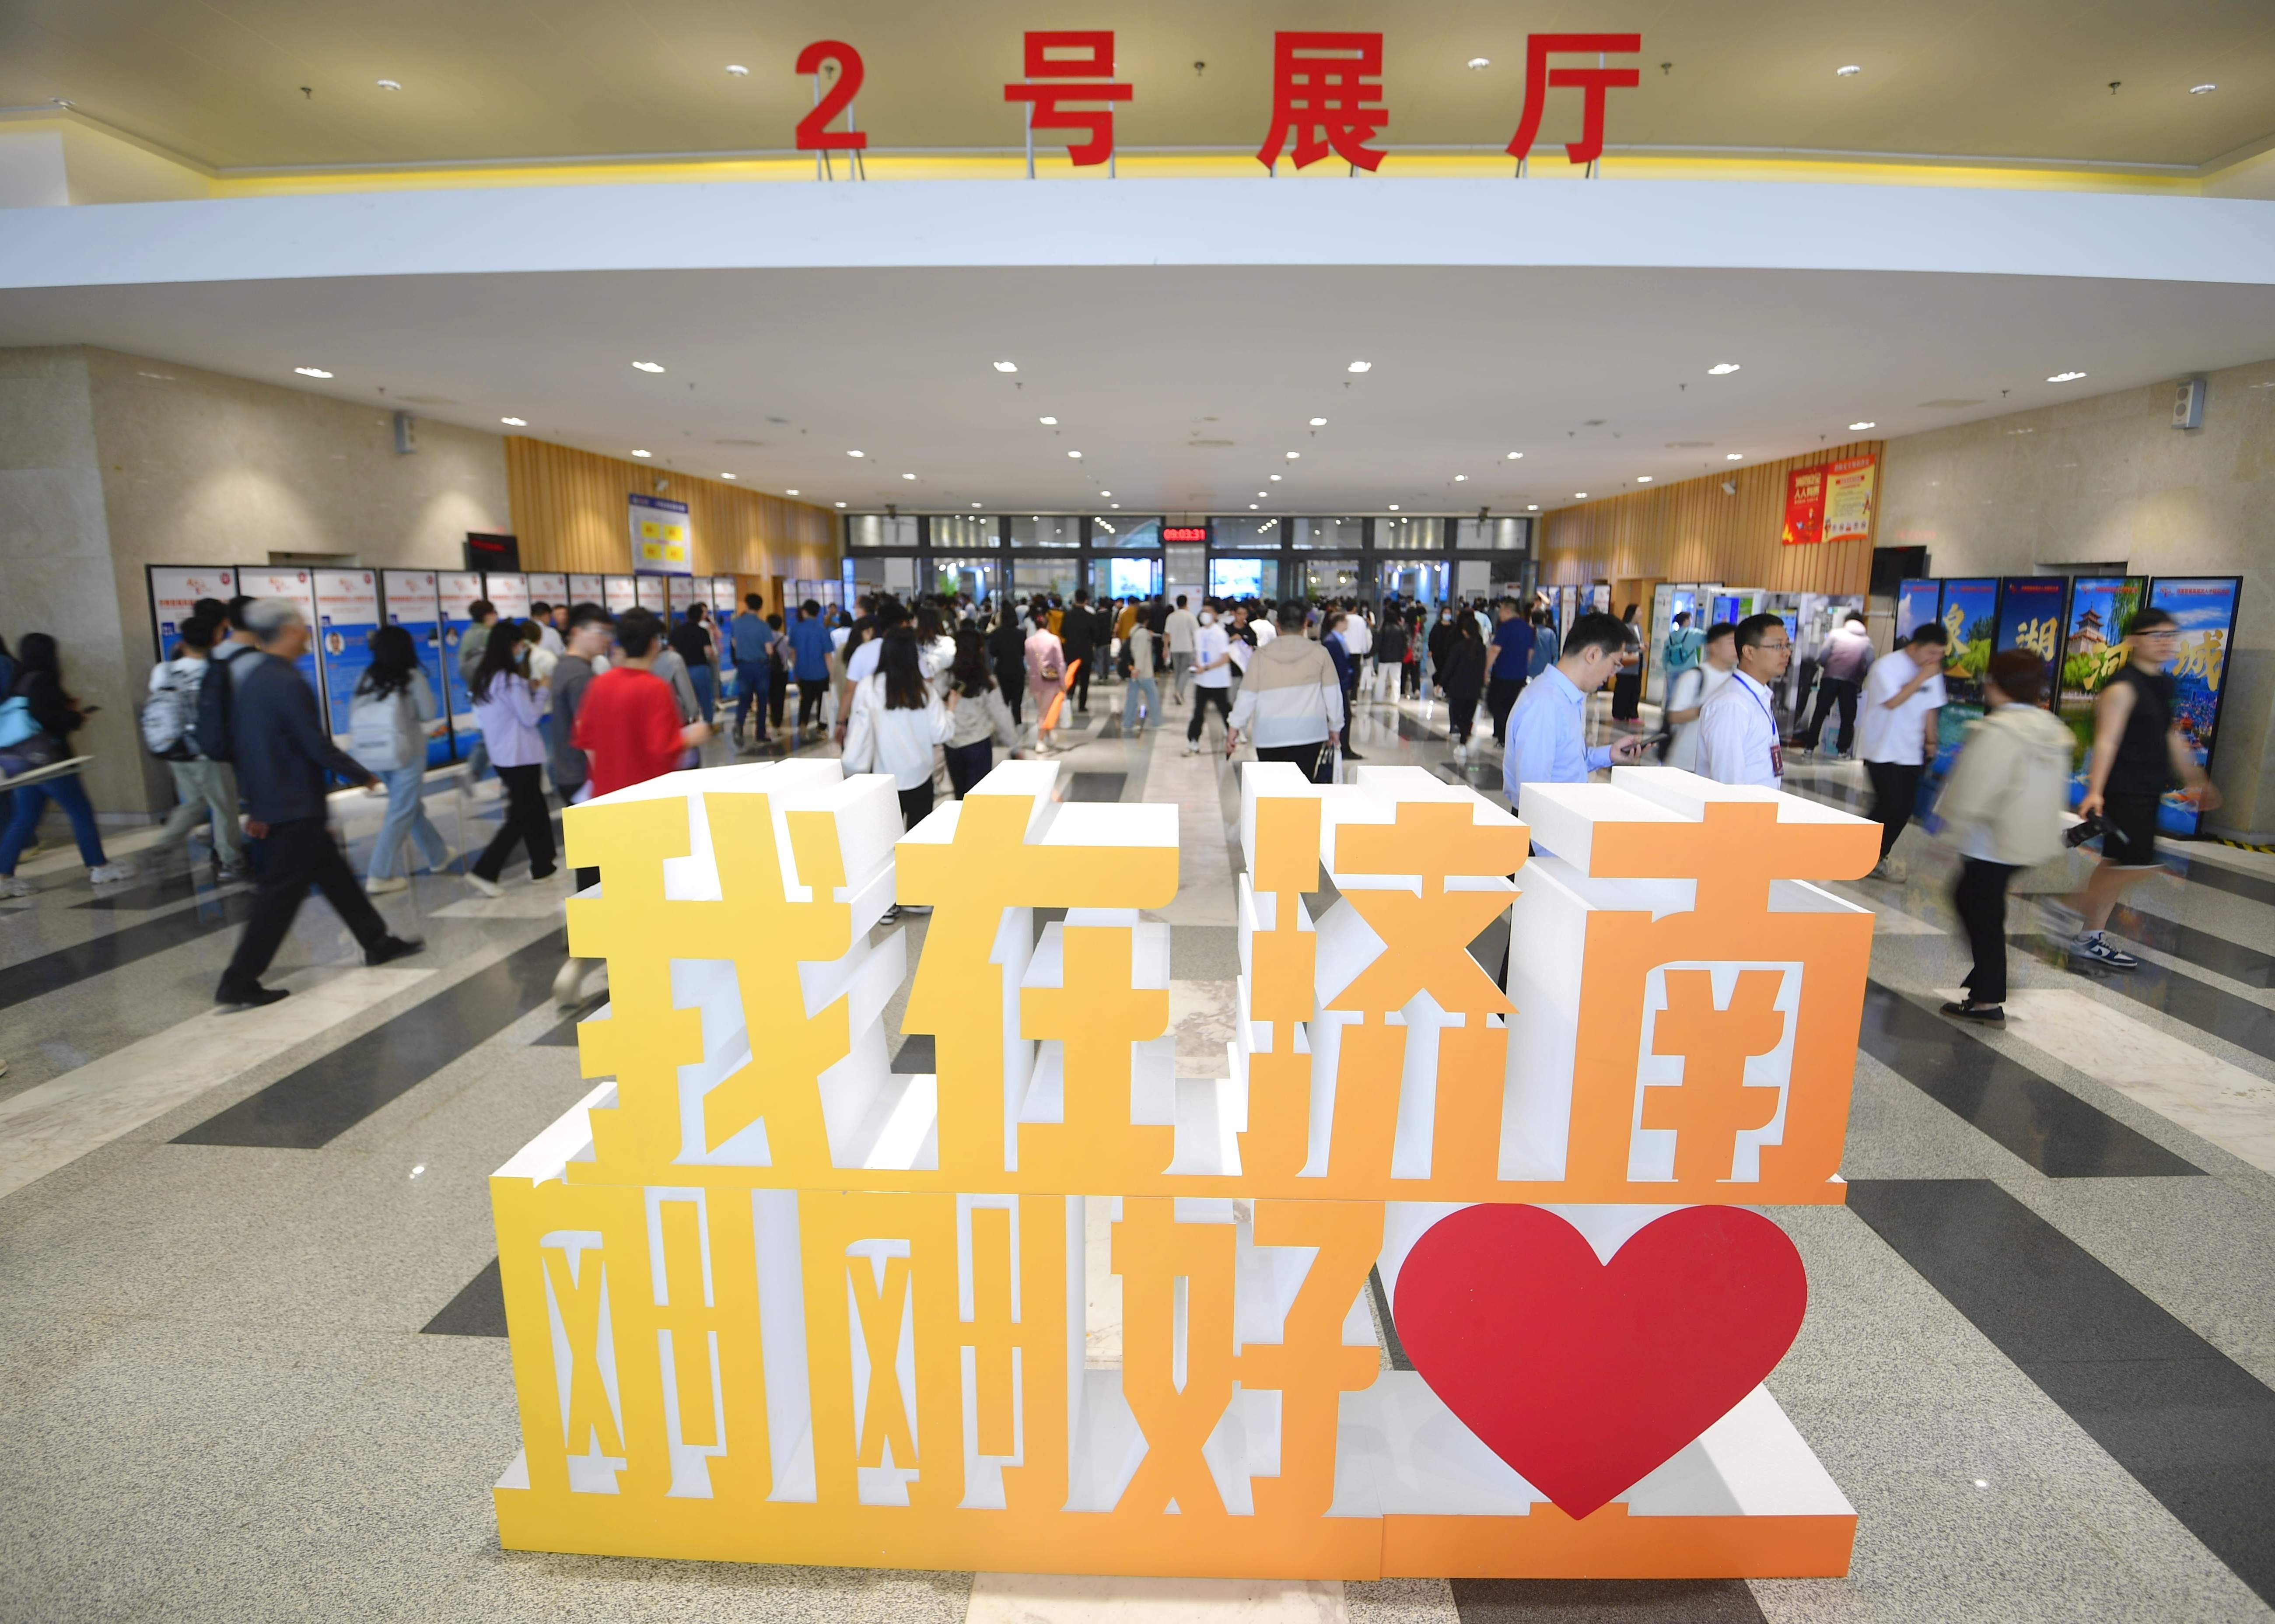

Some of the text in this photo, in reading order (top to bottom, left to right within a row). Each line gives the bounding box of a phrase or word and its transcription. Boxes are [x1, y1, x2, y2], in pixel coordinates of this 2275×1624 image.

[797, 32, 1640, 172] 2号展厅
[1163, 528, 1205, 541] 09:03:31
[2016, 616, 2058, 662] 湖
[2172, 629, 2223, 692] 城
[564, 792, 1883, 1204] 我在济南
[490, 1177, 1385, 1531] 刚刚好
